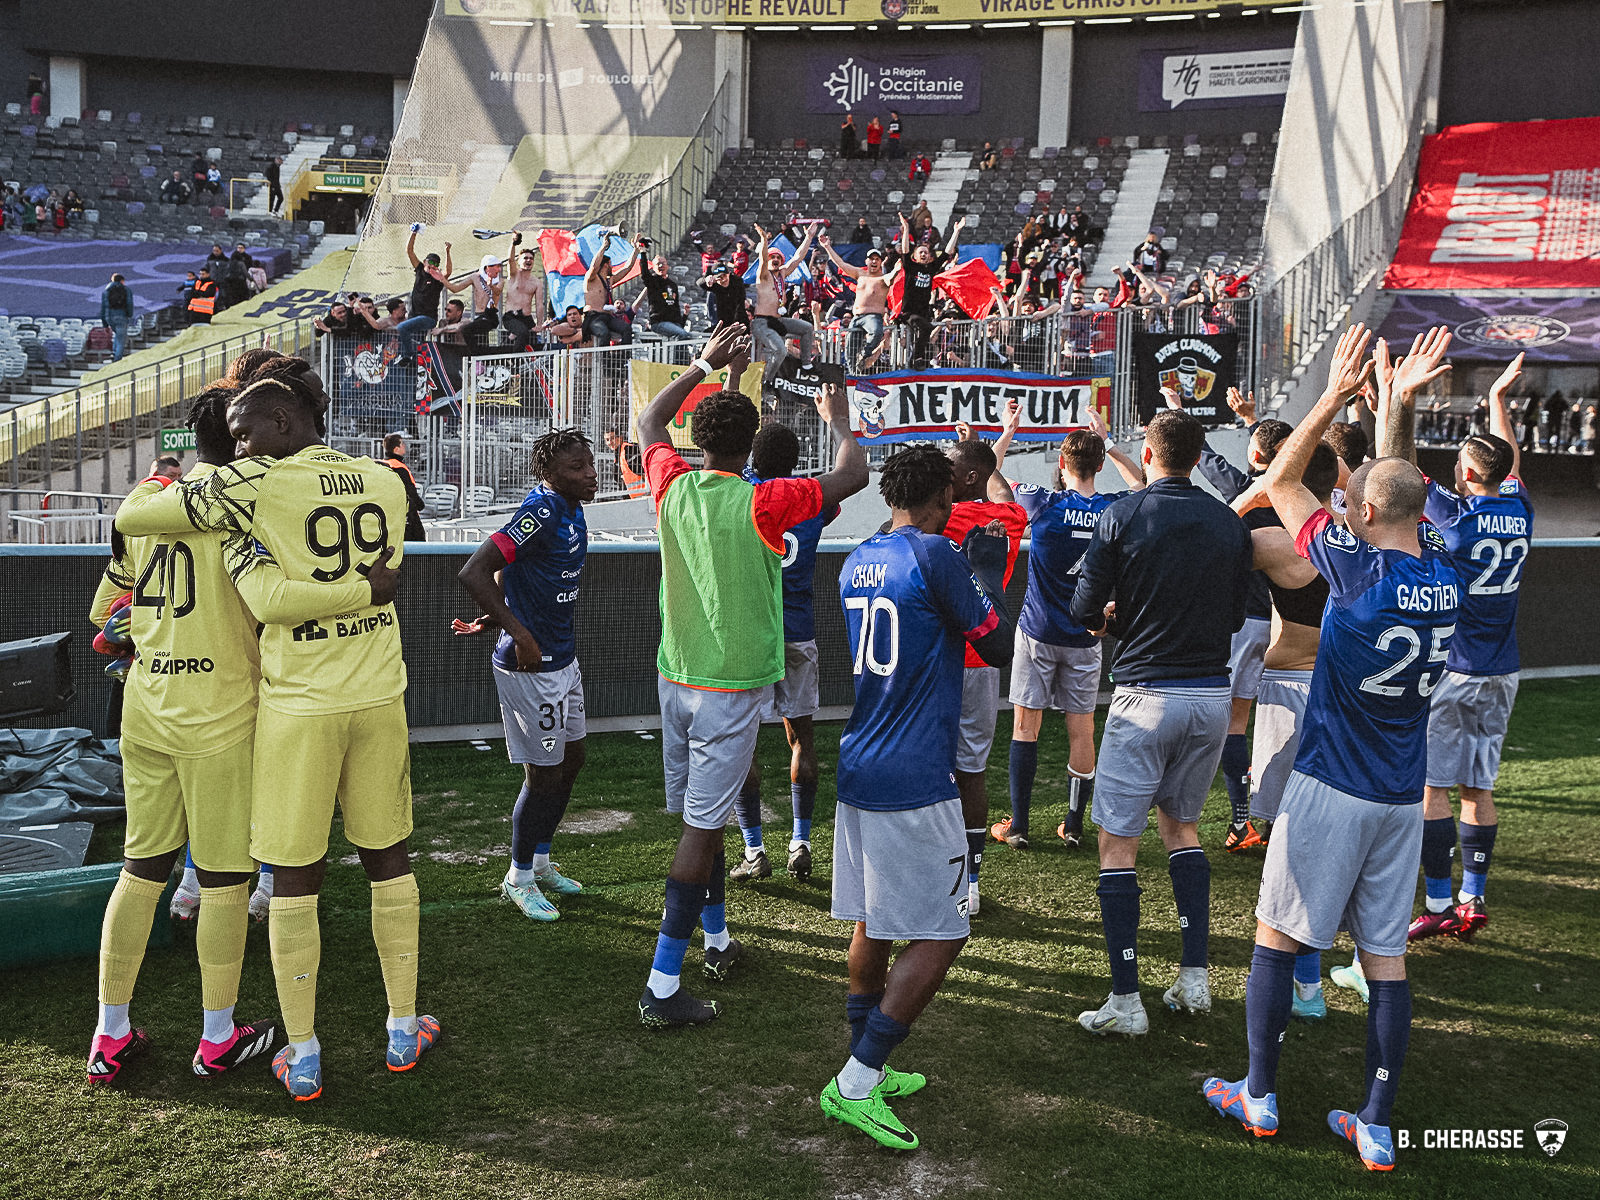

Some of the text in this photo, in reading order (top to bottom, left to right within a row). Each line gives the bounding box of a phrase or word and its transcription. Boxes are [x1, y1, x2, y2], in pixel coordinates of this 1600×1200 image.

[760, 0, 849, 15] REVAULT
[490, 71, 654, 85] MAIRIE DE TOULOUSE
[880, 67, 926, 78] La Région
[879, 76, 964, 92] Occitanie
[325, 174, 363, 186] SORTIE
[899, 383, 1080, 425] NEMETUM
[1477, 514, 1527, 535] MAURER
[305, 502, 388, 582] 99
[851, 563, 888, 589] CHAM
[1469, 537, 1529, 595] 22
[134, 540, 196, 620] 40
[844, 596, 899, 677] 70
[1358, 623, 1457, 697] 25
[12, 679, 32, 687] Canon
[538, 700, 565, 732] 31
[1124, 949, 1133, 959] 12
[1378, 1069, 1388, 1079] 25
